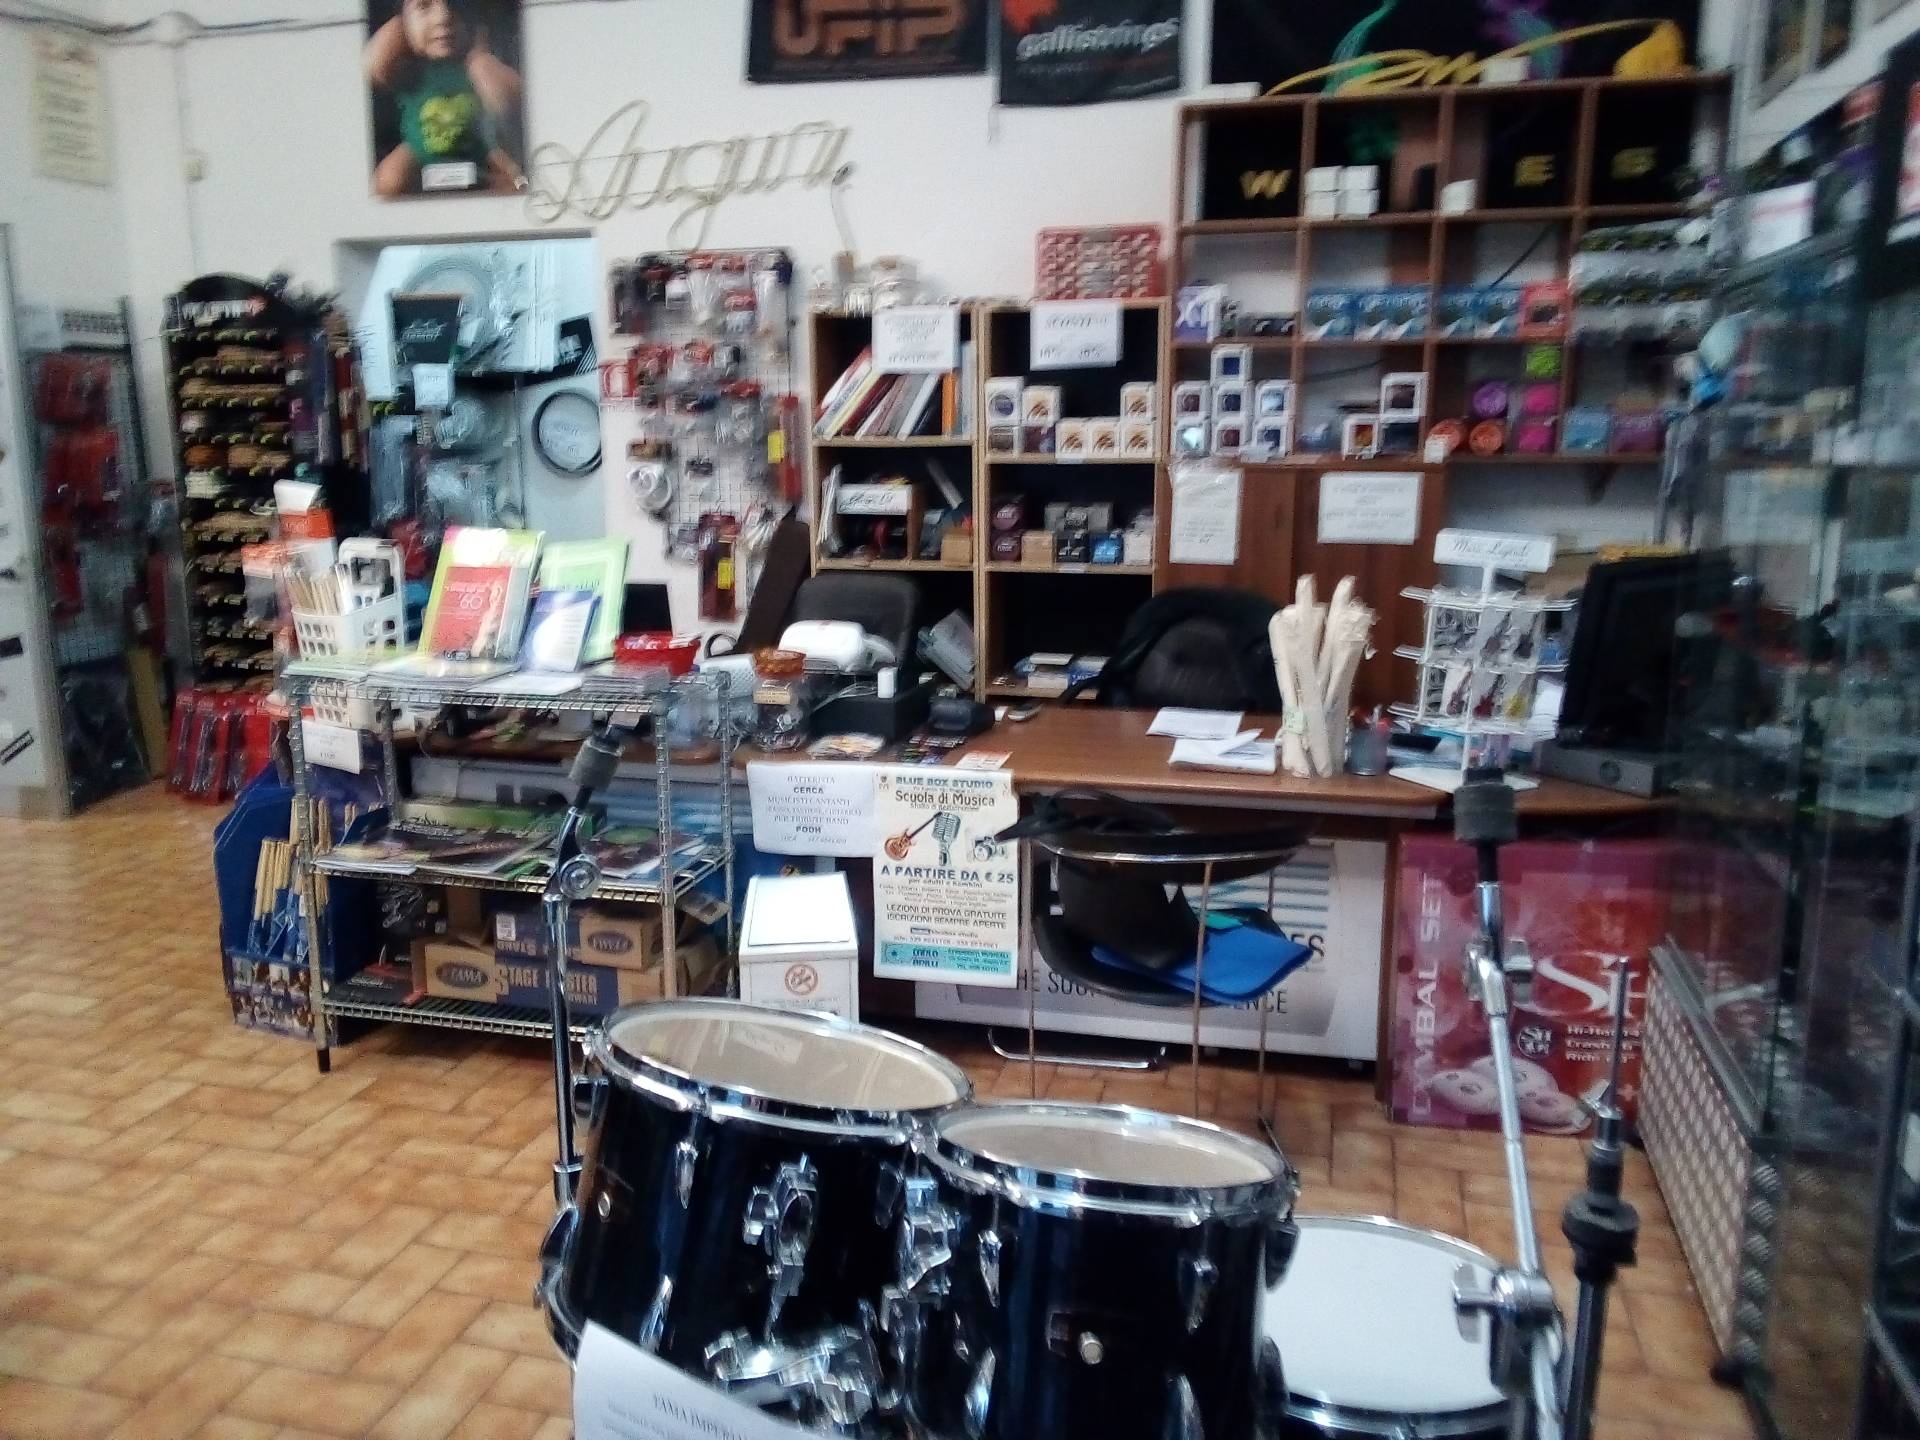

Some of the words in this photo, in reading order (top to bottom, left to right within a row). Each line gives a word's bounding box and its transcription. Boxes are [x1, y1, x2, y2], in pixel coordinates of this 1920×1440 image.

[793, 786, 824, 795] CERCA
[896, 776, 924, 786] BLUE
[927, 777, 949, 787] BOX
[952, 779, 994, 789] STUDIO
[895, 789, 935, 804] Scuola
[938, 792, 949, 804] di
[953, 793, 996, 807] Musica
[795, 825, 822, 835] POOH
[880, 864, 890, 876] A
[895, 865, 956, 880] PARTIRE
[960, 870, 980, 882] DA
[997, 872, 1015, 884] 25
[886, 903, 920, 914] LEZIONI
[921, 905, 930, 915] DI
[932, 906, 961, 917] PROVA
[964, 909, 1007, 921] GRATUITE
[1420, 872, 1442, 943] SET
[887, 912, 933, 924] ISCRIZIONI
[934, 915, 970, 927] SEMPRE
[972, 919, 1007, 930] APERTE
[498, 966, 539, 995] STAGE
